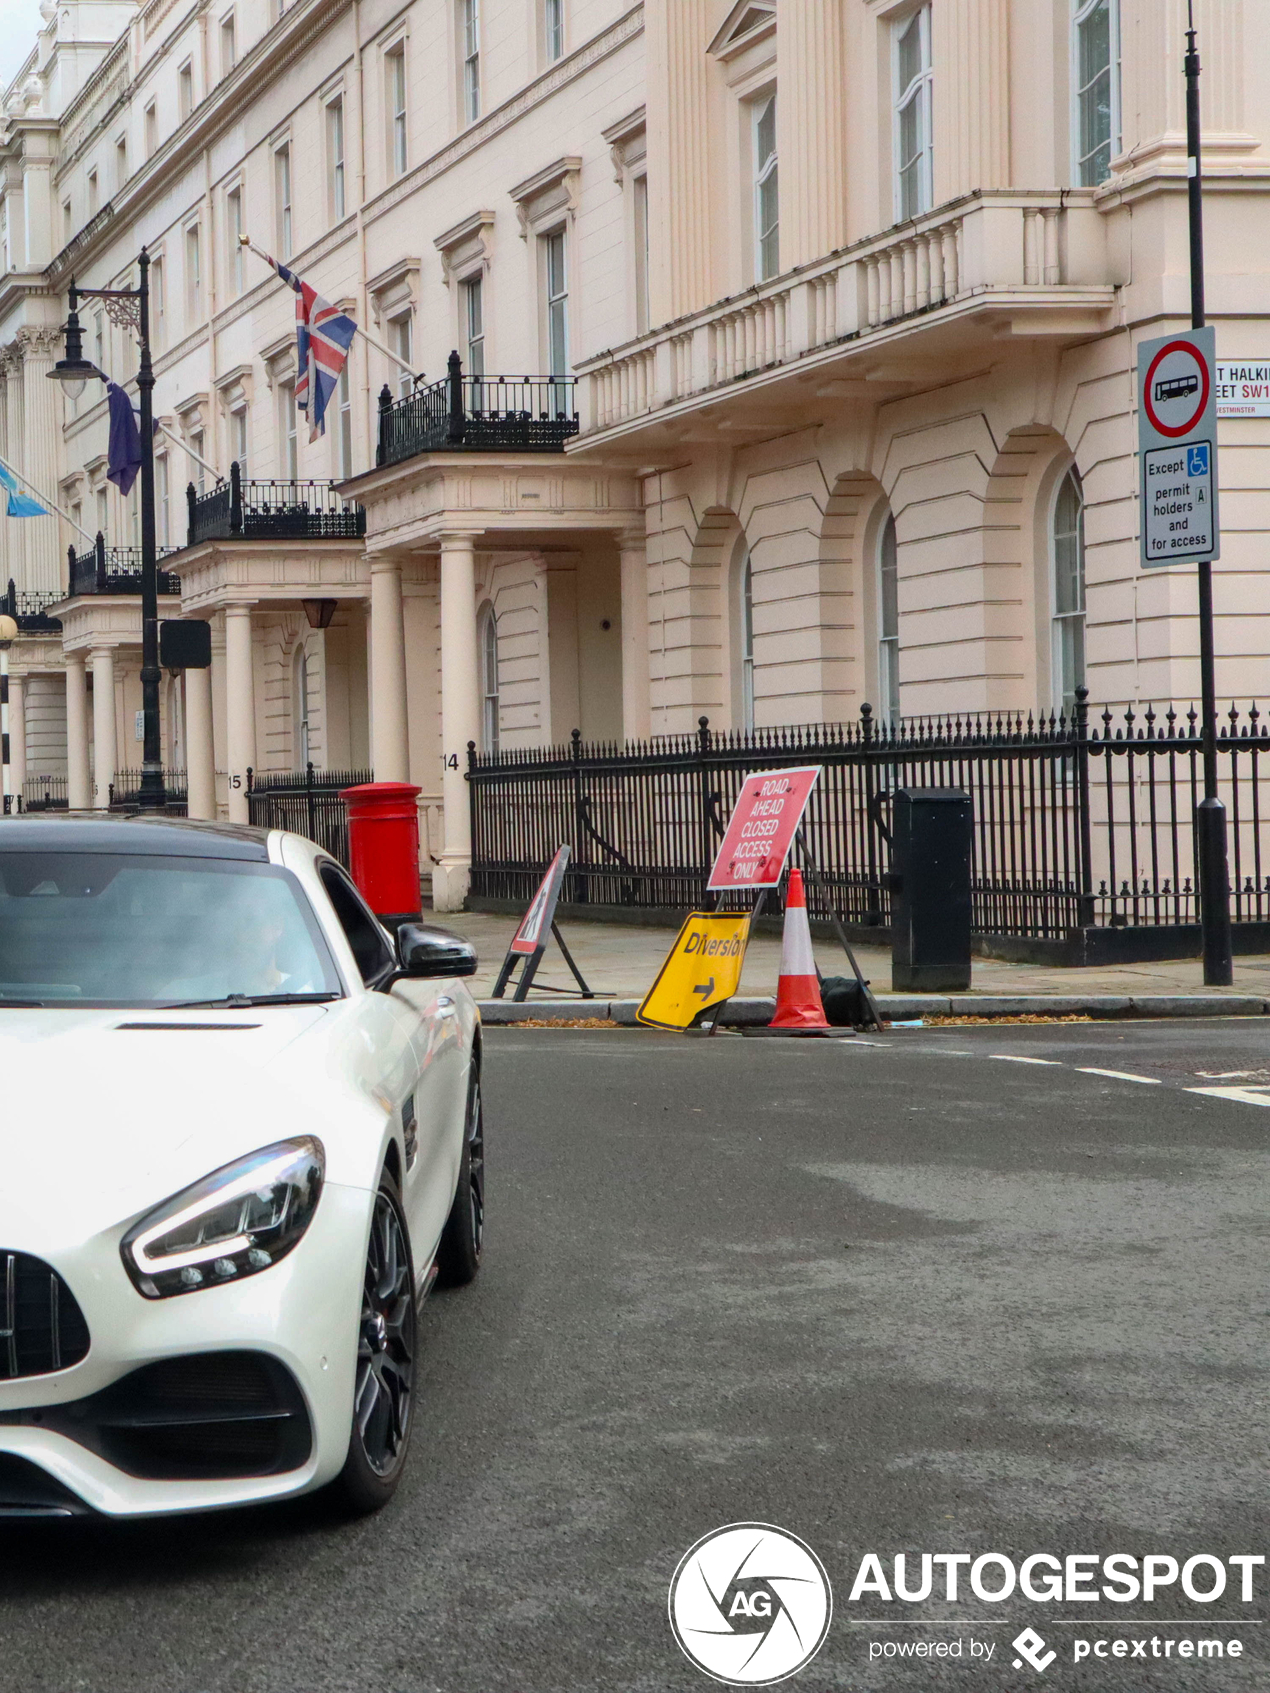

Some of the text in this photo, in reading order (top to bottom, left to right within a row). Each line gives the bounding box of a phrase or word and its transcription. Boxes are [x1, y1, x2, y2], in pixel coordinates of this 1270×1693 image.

[1230, 367, 1270, 381] HALKI
[1217, 406, 1256, 414] ESTMINSTER
[1149, 459, 1184, 476] Except
[1155, 483, 1205, 503] permit A
[1154, 501, 1193, 517] holders
[1169, 517, 1189, 531] and
[1152, 535, 1207, 550] for access
[443, 753, 459, 772] 14
[228, 775, 241, 789] 15
[761, 779, 788, 796] ROAD
[751, 801, 783, 816] AHEAD
[742, 821, 778, 837] CLOSED
[733, 841, 772, 858] ACCESS
[734, 863, 757, 879] ONLY
[685, 932, 746, 956] Diversion
